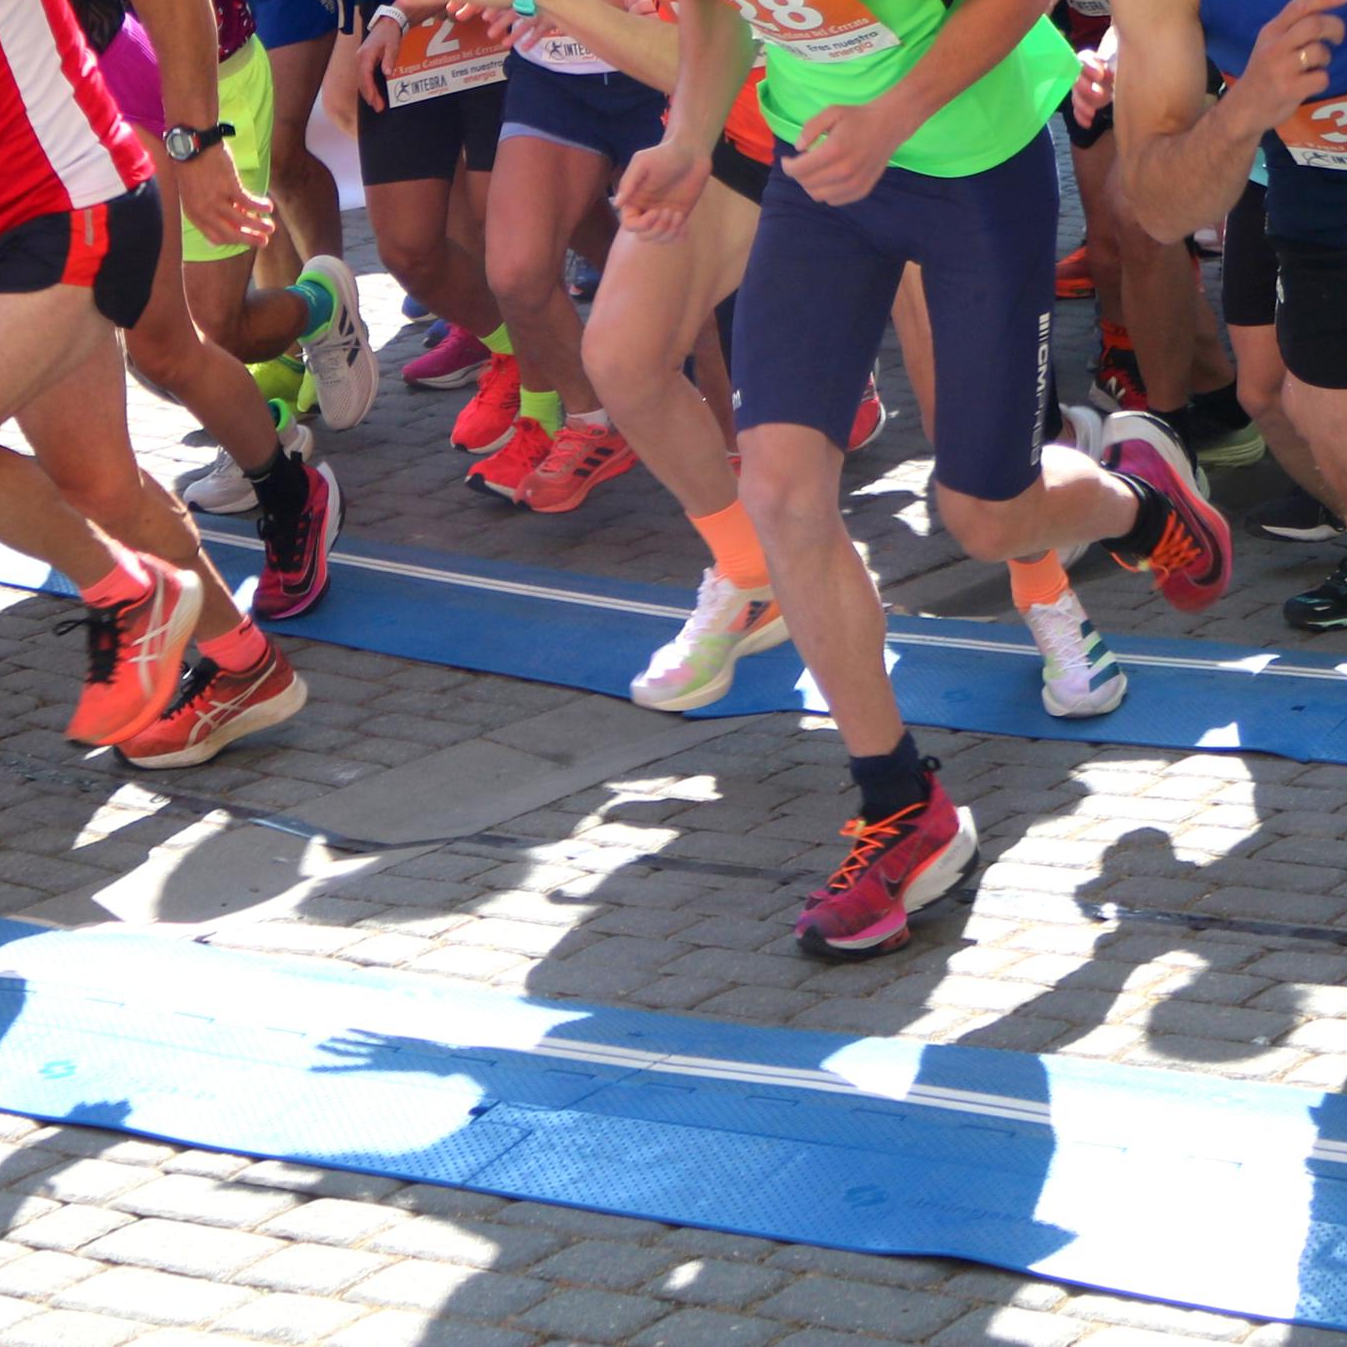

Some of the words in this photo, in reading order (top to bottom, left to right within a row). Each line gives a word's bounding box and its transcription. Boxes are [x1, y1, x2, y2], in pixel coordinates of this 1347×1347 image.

[421, 15, 461, 59] 2
[806, 43, 832, 53] Eres
[833, 30, 879, 50] nuestra
[411, 75, 448, 93] INTEGRA
[451, 69, 469, 79] Eres
